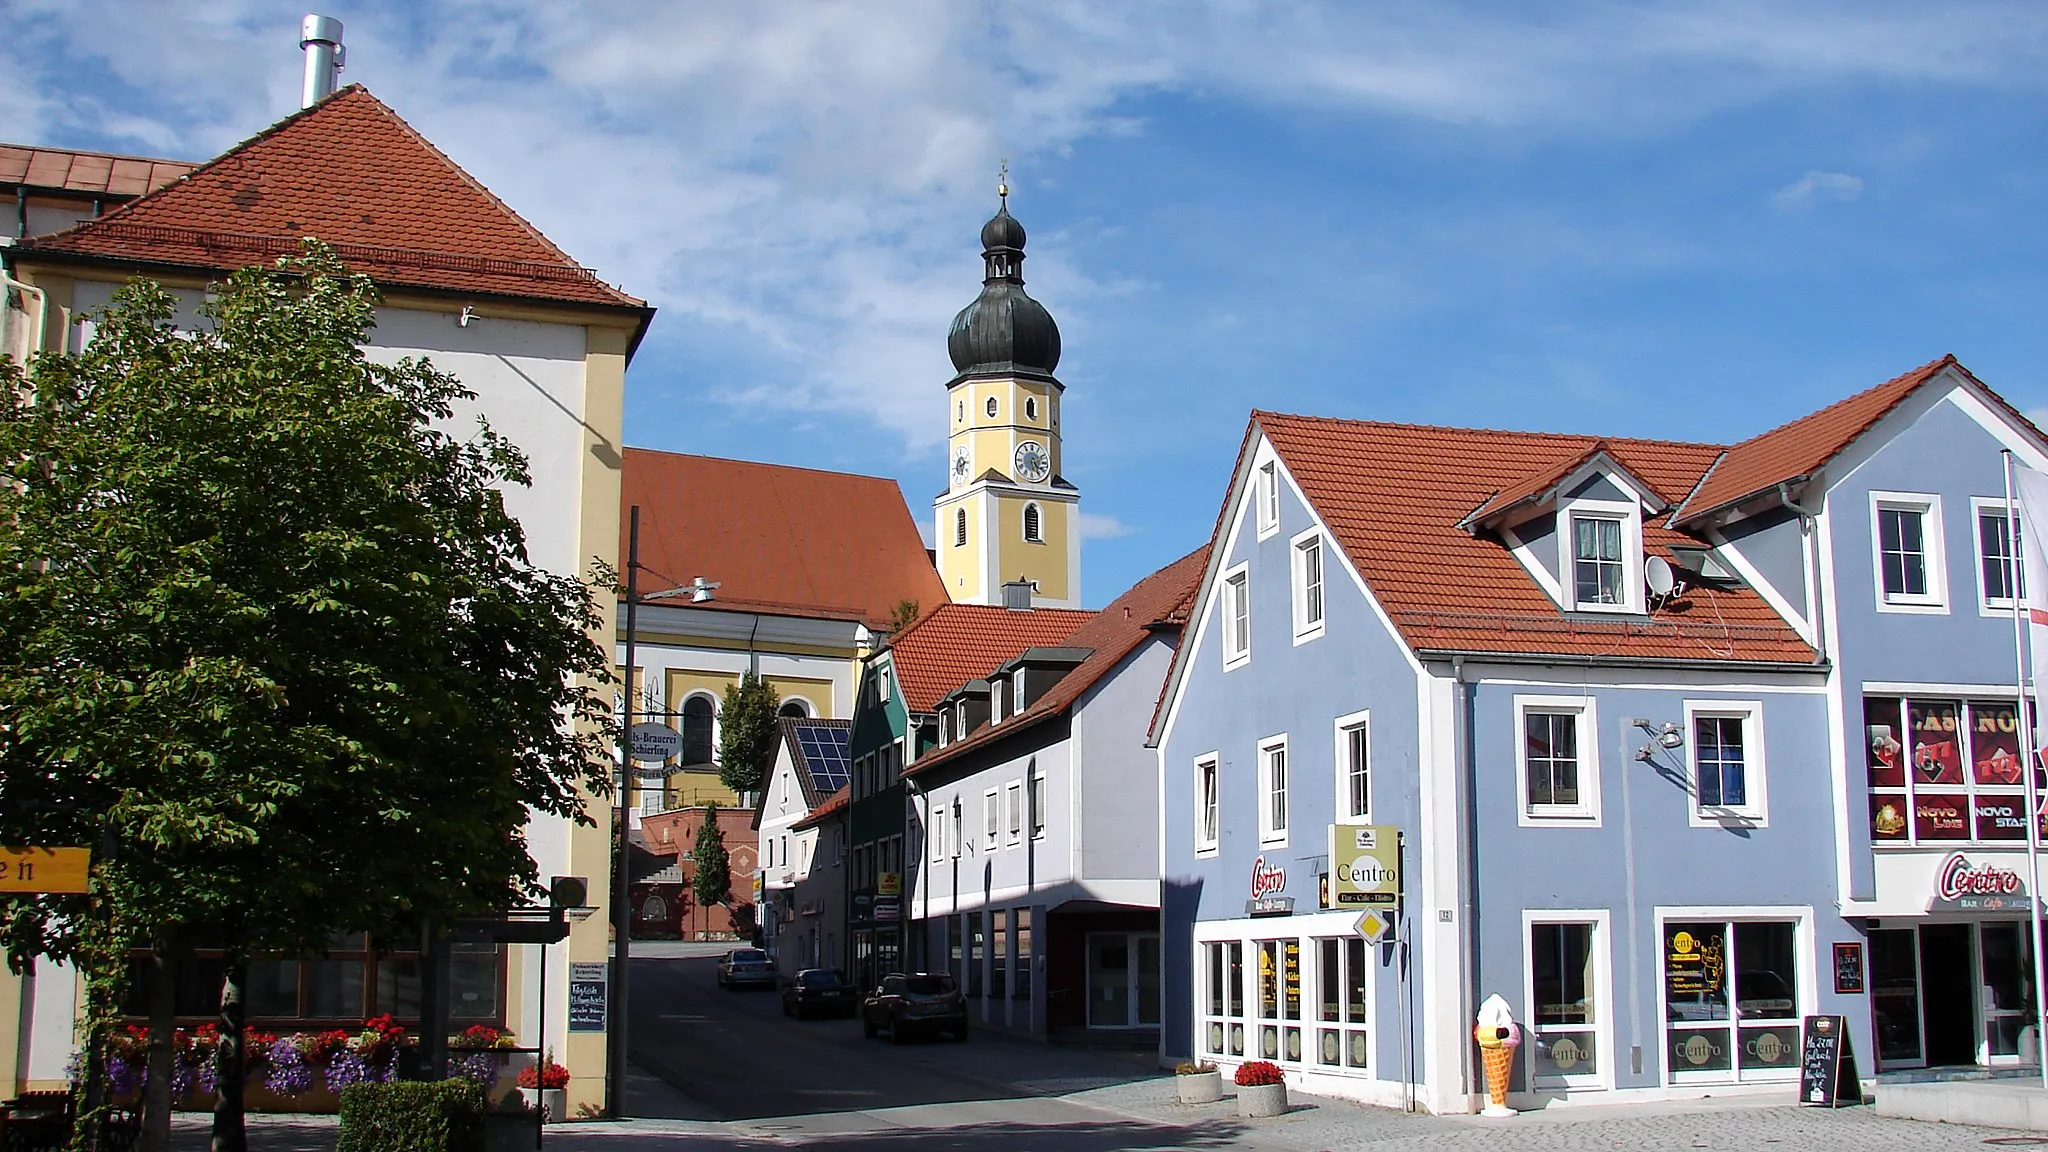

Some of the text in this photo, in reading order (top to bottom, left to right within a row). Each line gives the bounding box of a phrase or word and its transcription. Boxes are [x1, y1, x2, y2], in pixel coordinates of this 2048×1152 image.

[1911, 709, 2016, 733] CASNO
[631, 743, 669, 756] Schierling
[1337, 864, 1396, 882] Centro
[1942, 853, 2018, 899] Centro
[1667, 937, 1701, 948] Centro
[1675, 1042, 1721, 1058] Centro
[1747, 1041, 1791, 1056] Centro
